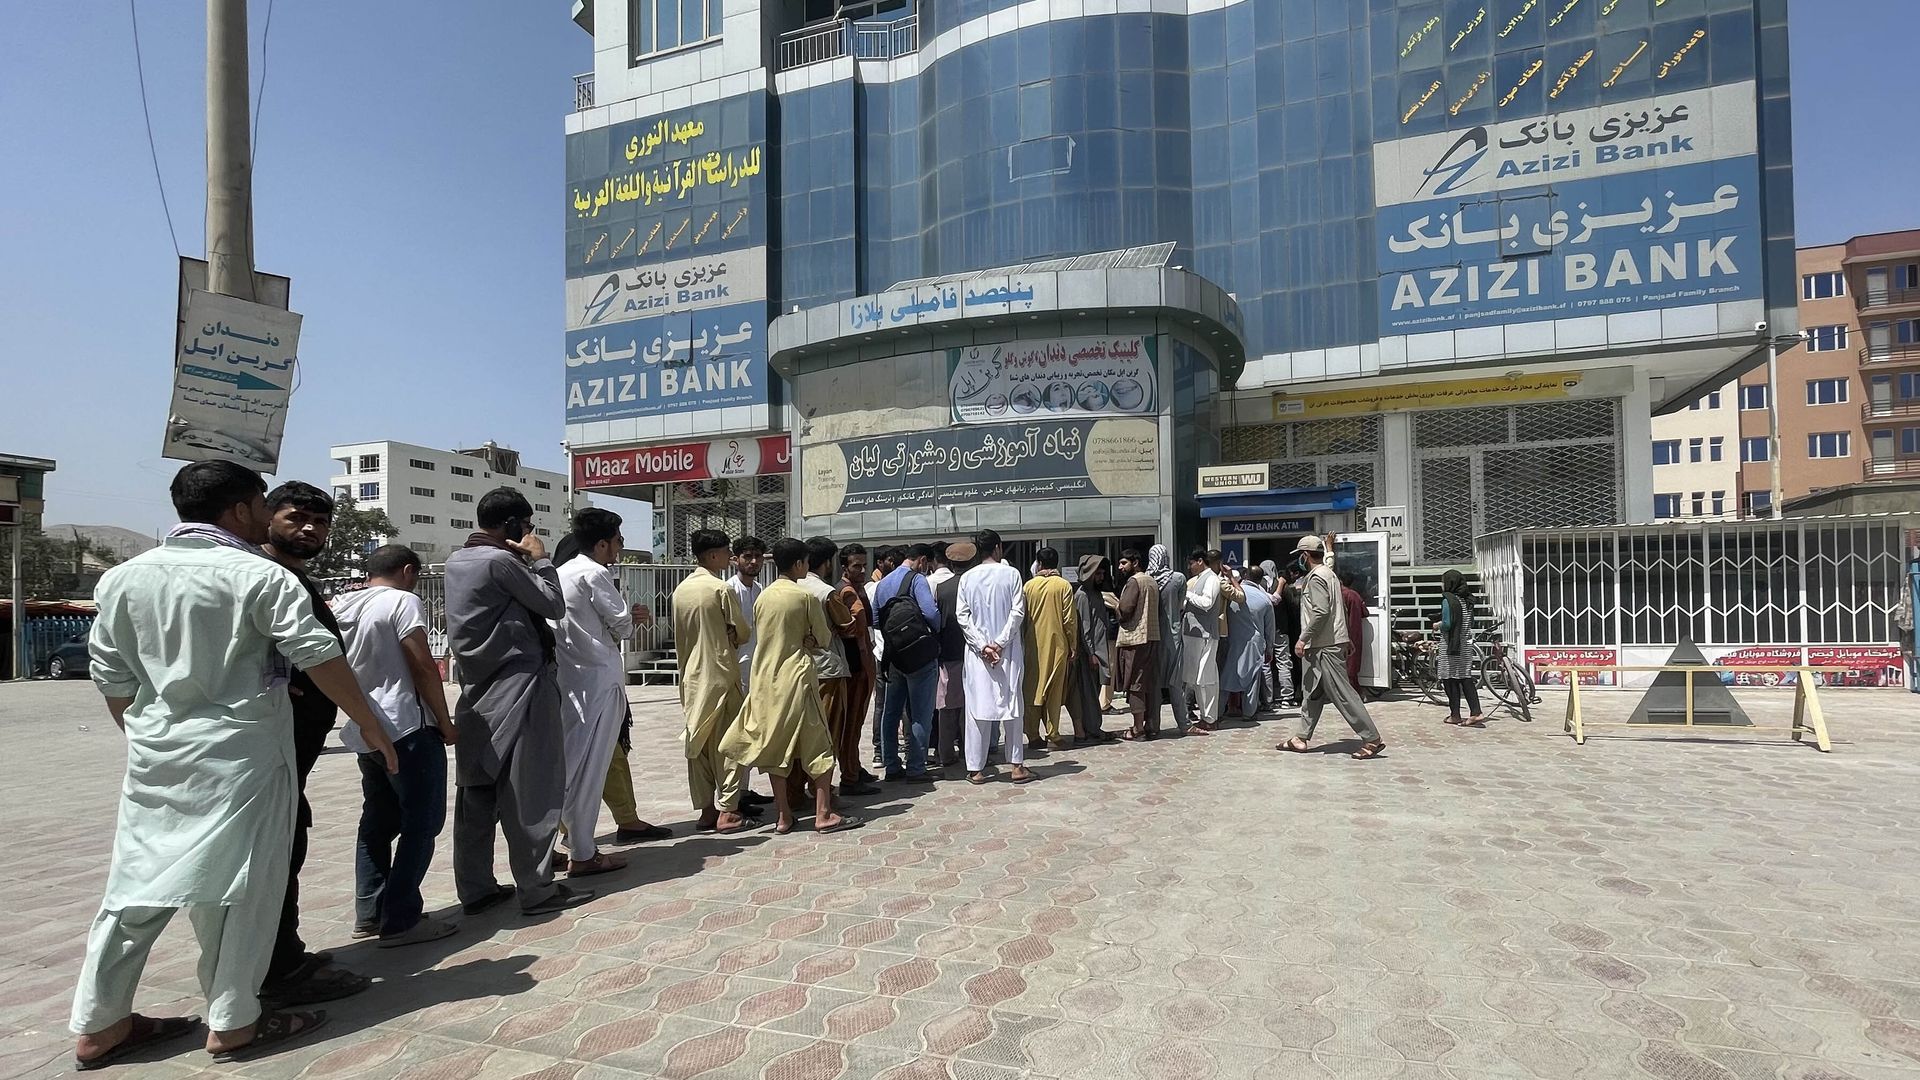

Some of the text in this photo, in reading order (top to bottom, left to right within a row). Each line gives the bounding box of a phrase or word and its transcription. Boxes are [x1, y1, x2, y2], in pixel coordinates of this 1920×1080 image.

[1499, 59, 1543, 107] طبقات صوت
[672, 119, 704, 145] معهد
[1498, 104, 1689, 149] عزیزی بانک
[1496, 134, 1694, 179] Azizi Bank
[1388, 184, 1740, 254] عزیزی بانک
[625, 262, 727, 290] عزیزی بانک
[1390, 235, 1740, 312] AZIZI BANK
[624, 284, 730, 312] Azizi Bank
[891, 287, 957, 322] فامیلی
[1642, 292, 1676, 303] Panjsad
[1678, 288, 1706, 300] Family
[1708, 285, 1740, 295] Branch
[851, 302, 884, 329] پلازا
[202, 321, 279, 346] دندان
[566, 321, 752, 367] عزیزی بانک
[567, 359, 752, 410] AZIZI BANK
[585, 457, 629, 478] Maaz
[635, 449, 694, 474] Mobile
[850, 427, 1081, 479] نهاد آموزشی و مشورتی لیان
[964, 489, 979, 499] علوم
[1233, 521, 1299, 531] AZIZI BANK ATM
[1371, 516, 1402, 528] ATM
[1552, 650, 1578, 661] موبایل
[1580, 650, 1613, 661] فروشگاه
[1739, 650, 1765, 659] موبایل
[1767, 649, 1801, 658] فروشگاه
[1836, 648, 1862, 659] موبایل
[1864, 648, 1901, 658] فروشگاه
